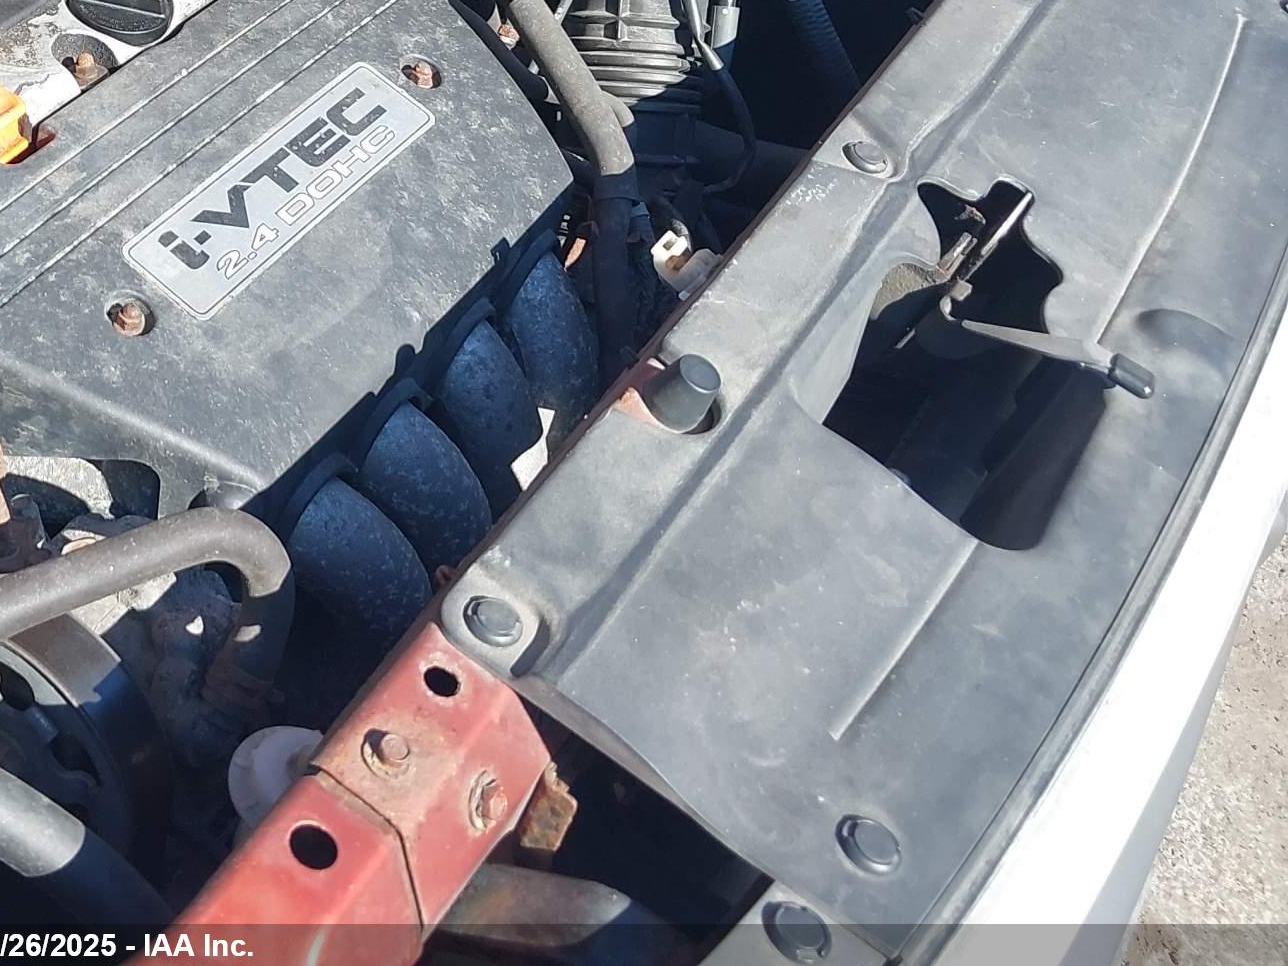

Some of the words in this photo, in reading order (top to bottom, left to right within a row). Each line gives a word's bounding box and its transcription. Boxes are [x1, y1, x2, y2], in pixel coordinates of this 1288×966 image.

[158, 87, 388, 270] i-VTEC
[216, 222, 281, 280] 2.4
[274, 124, 396, 226] DOHC
